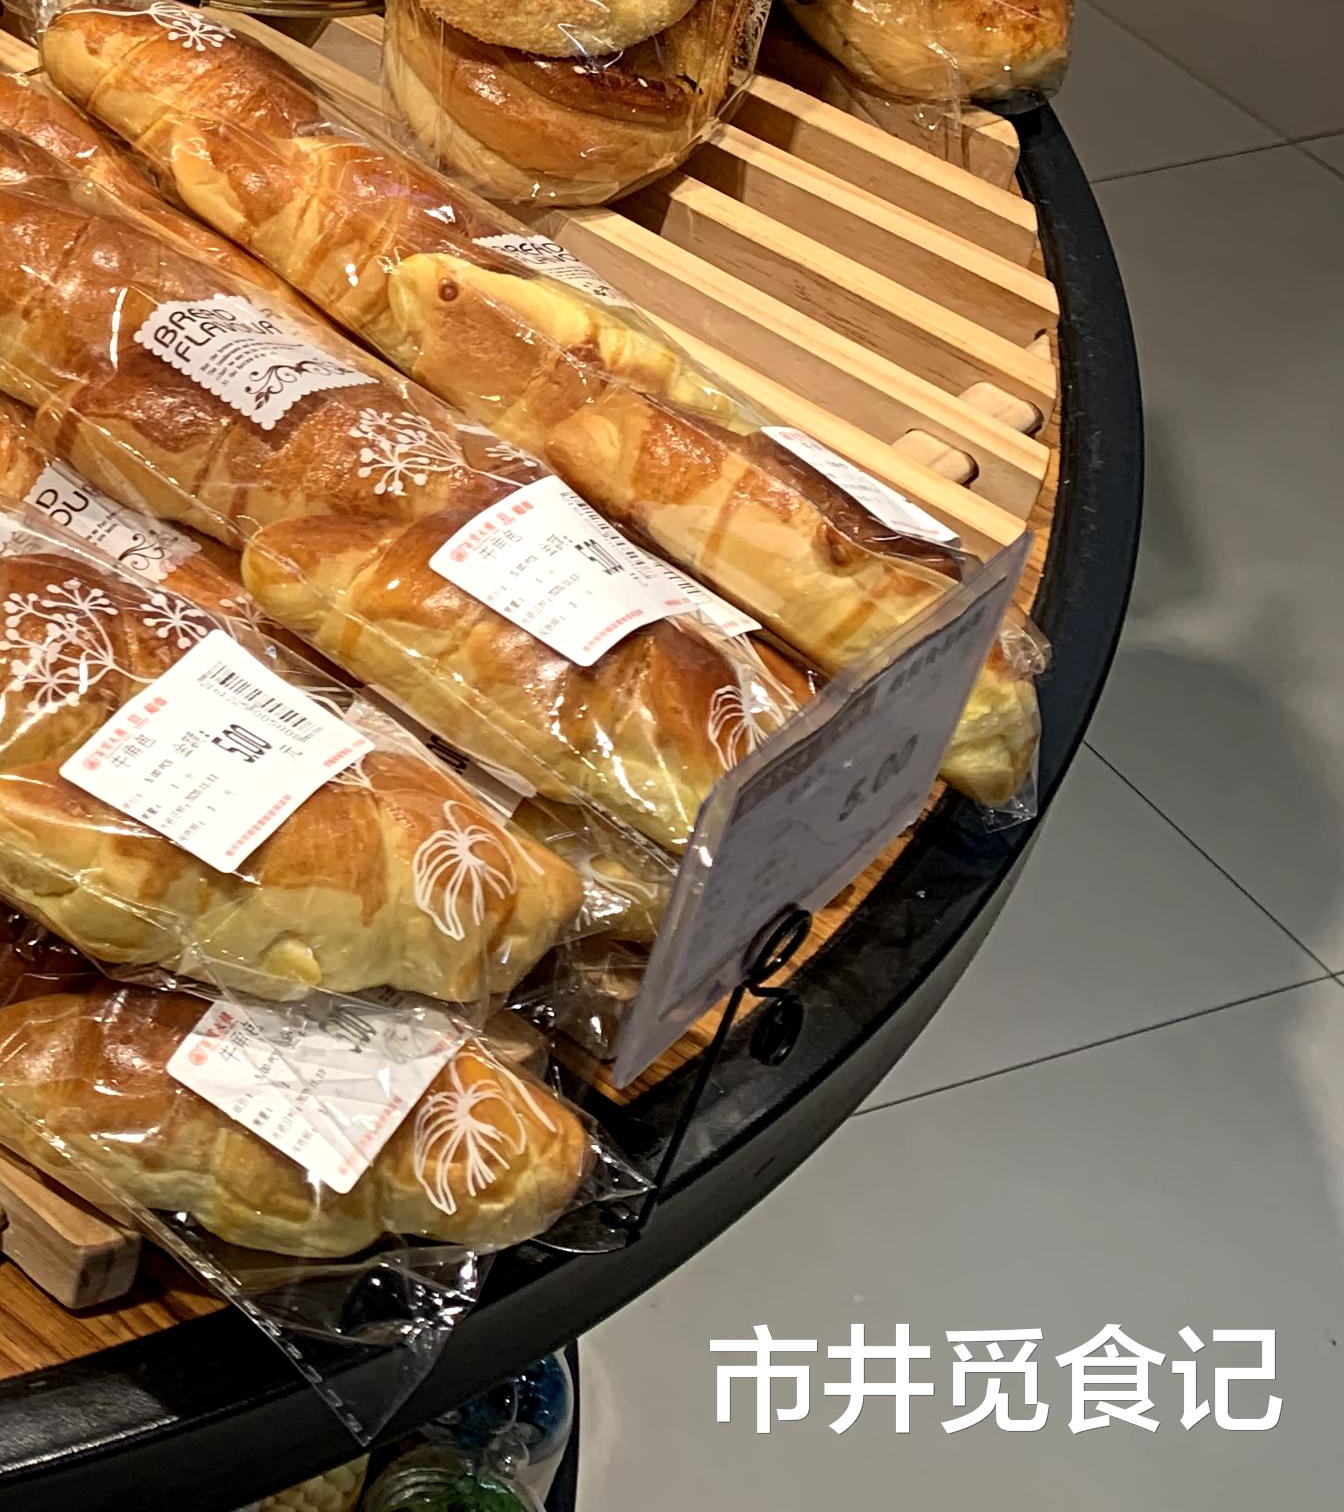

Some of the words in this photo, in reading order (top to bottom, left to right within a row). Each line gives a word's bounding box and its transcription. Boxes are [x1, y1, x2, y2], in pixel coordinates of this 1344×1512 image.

[154, 308, 237, 349] BREAD
[574, 536, 626, 577] 5.00
[107, 730, 157, 771] 牛角包
[211, 719, 274, 767] 5.00
